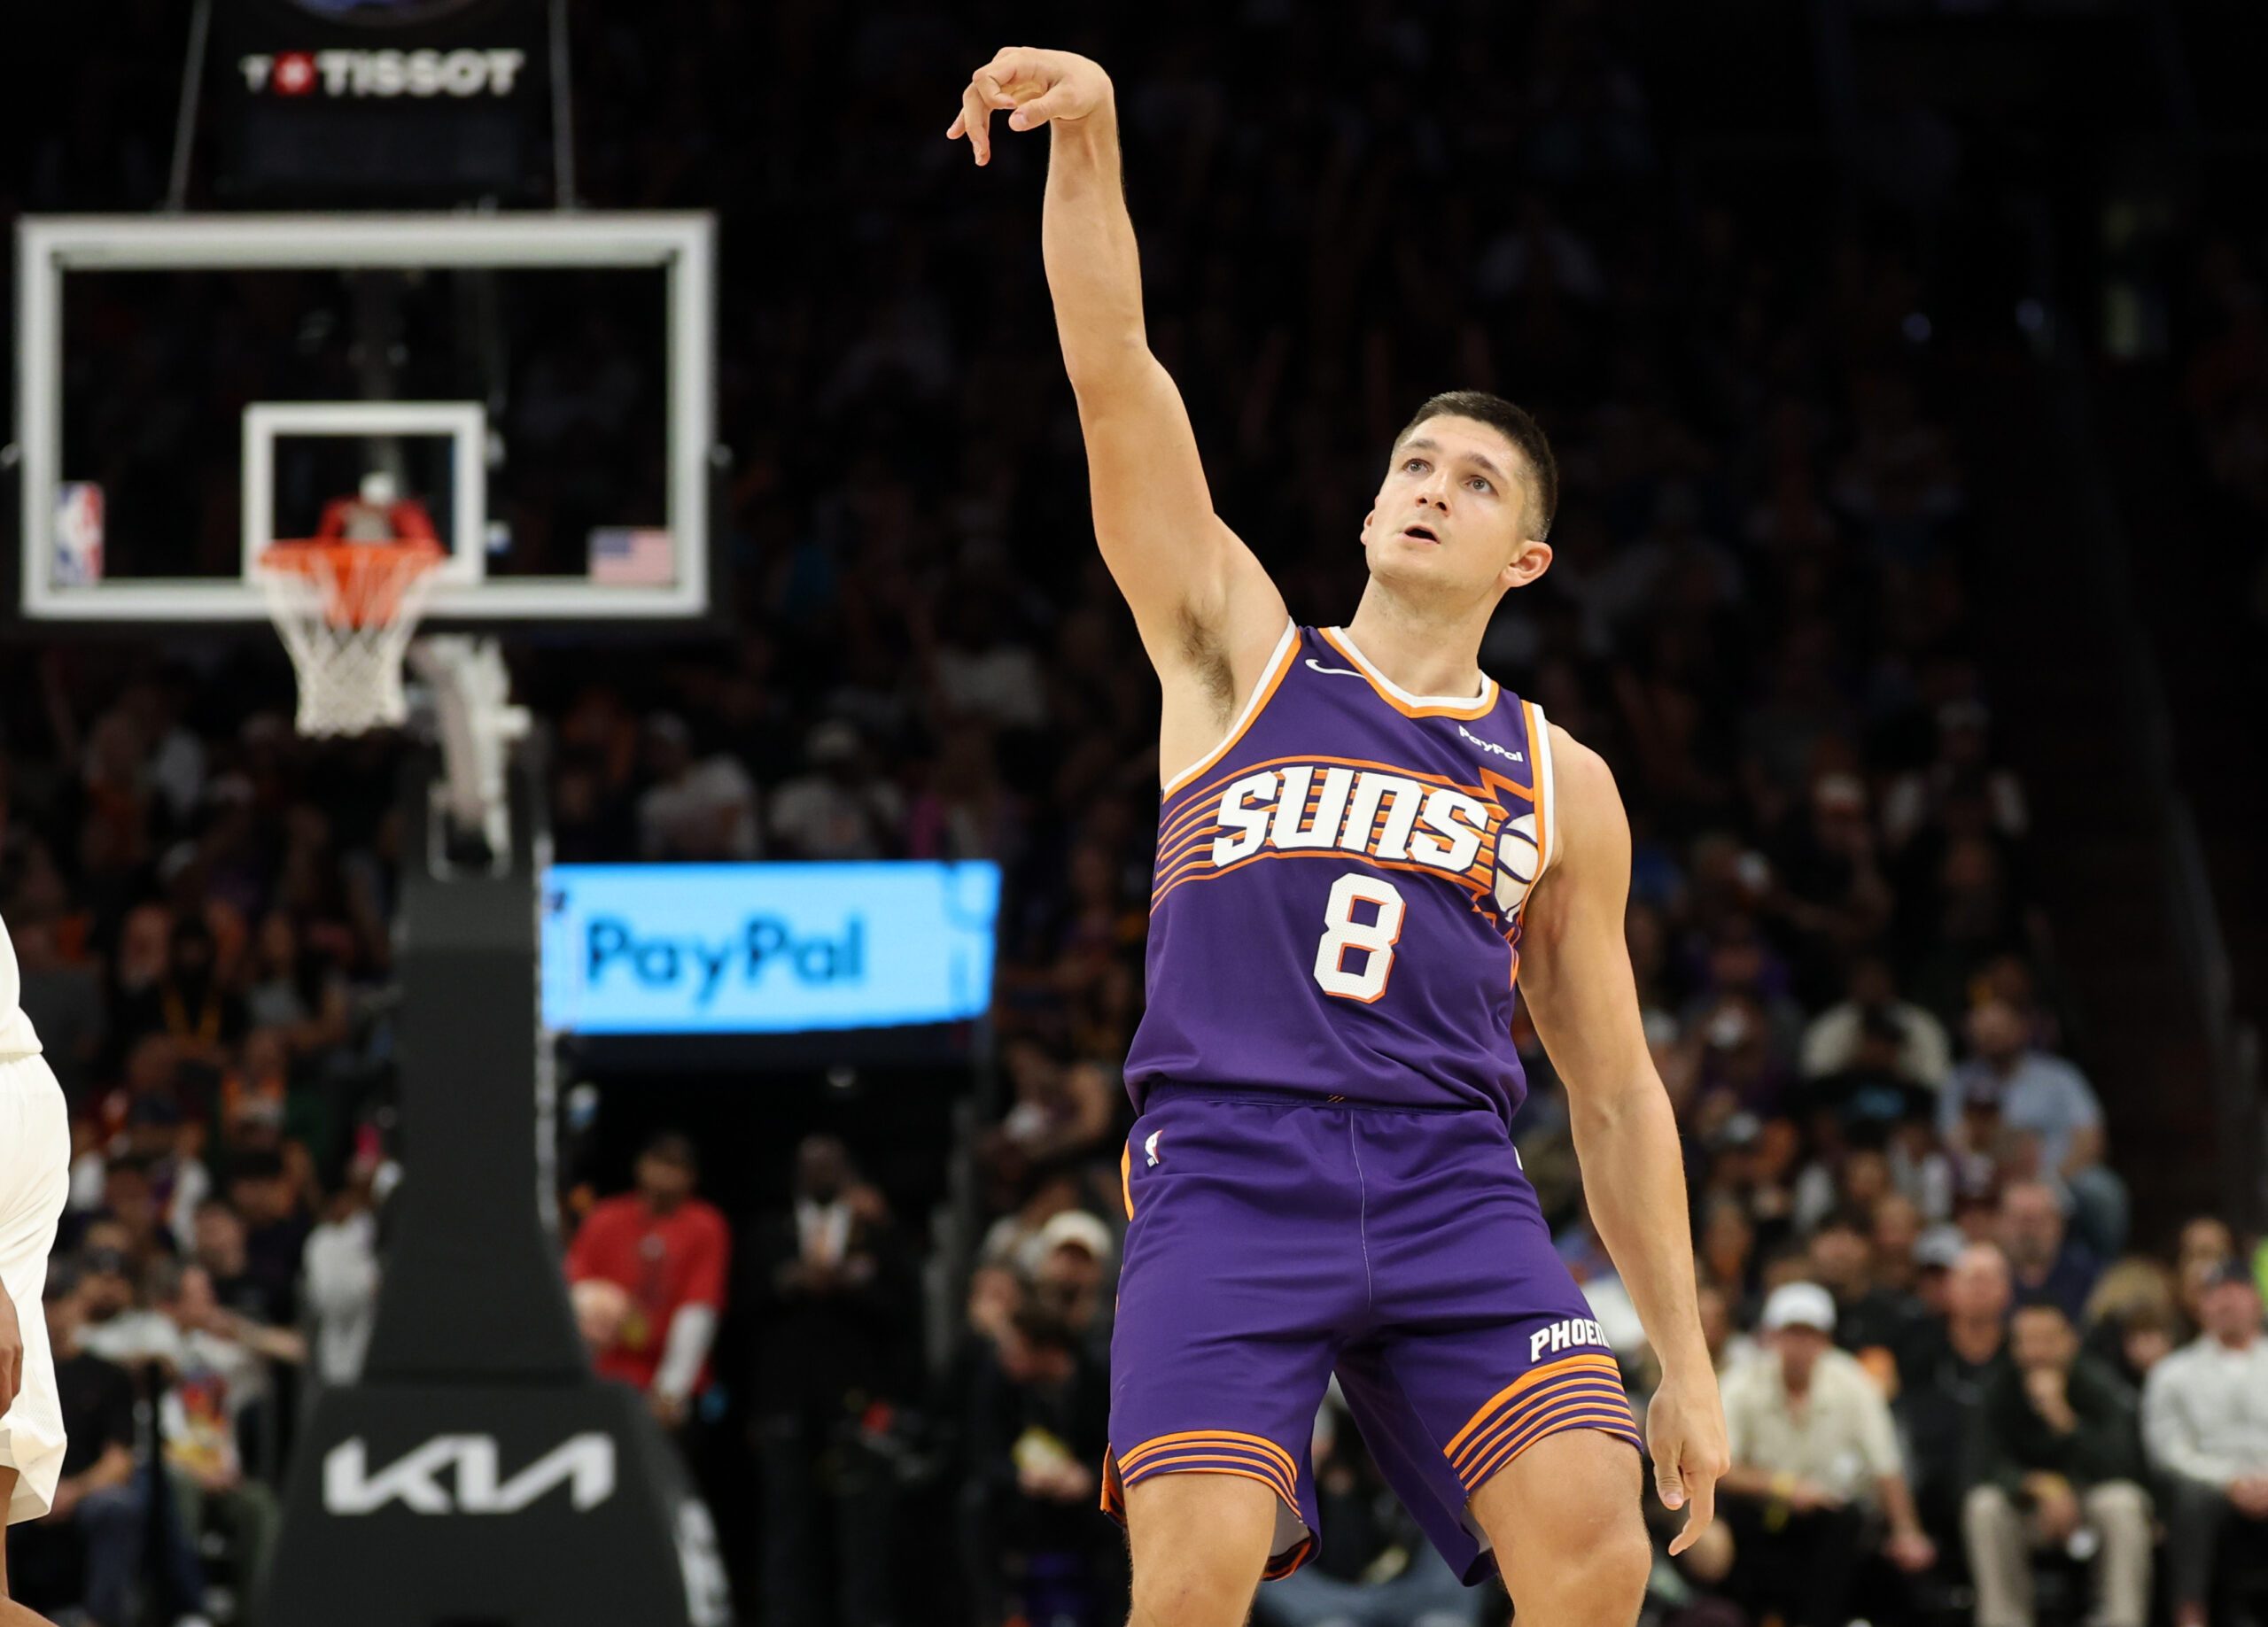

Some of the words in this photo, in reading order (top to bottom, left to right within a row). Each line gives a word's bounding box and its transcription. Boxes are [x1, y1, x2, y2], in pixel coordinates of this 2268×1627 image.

[316, 48, 525, 97] TISSOT
[1458, 724, 1524, 762] PayPal
[1210, 765, 1491, 873] SUNS
[587, 911, 866, 1008] PayPal
[1313, 872, 1407, 1004] 8
[1529, 1318, 1611, 1364] PHOEN
[322, 1432, 617, 1515] KIA
